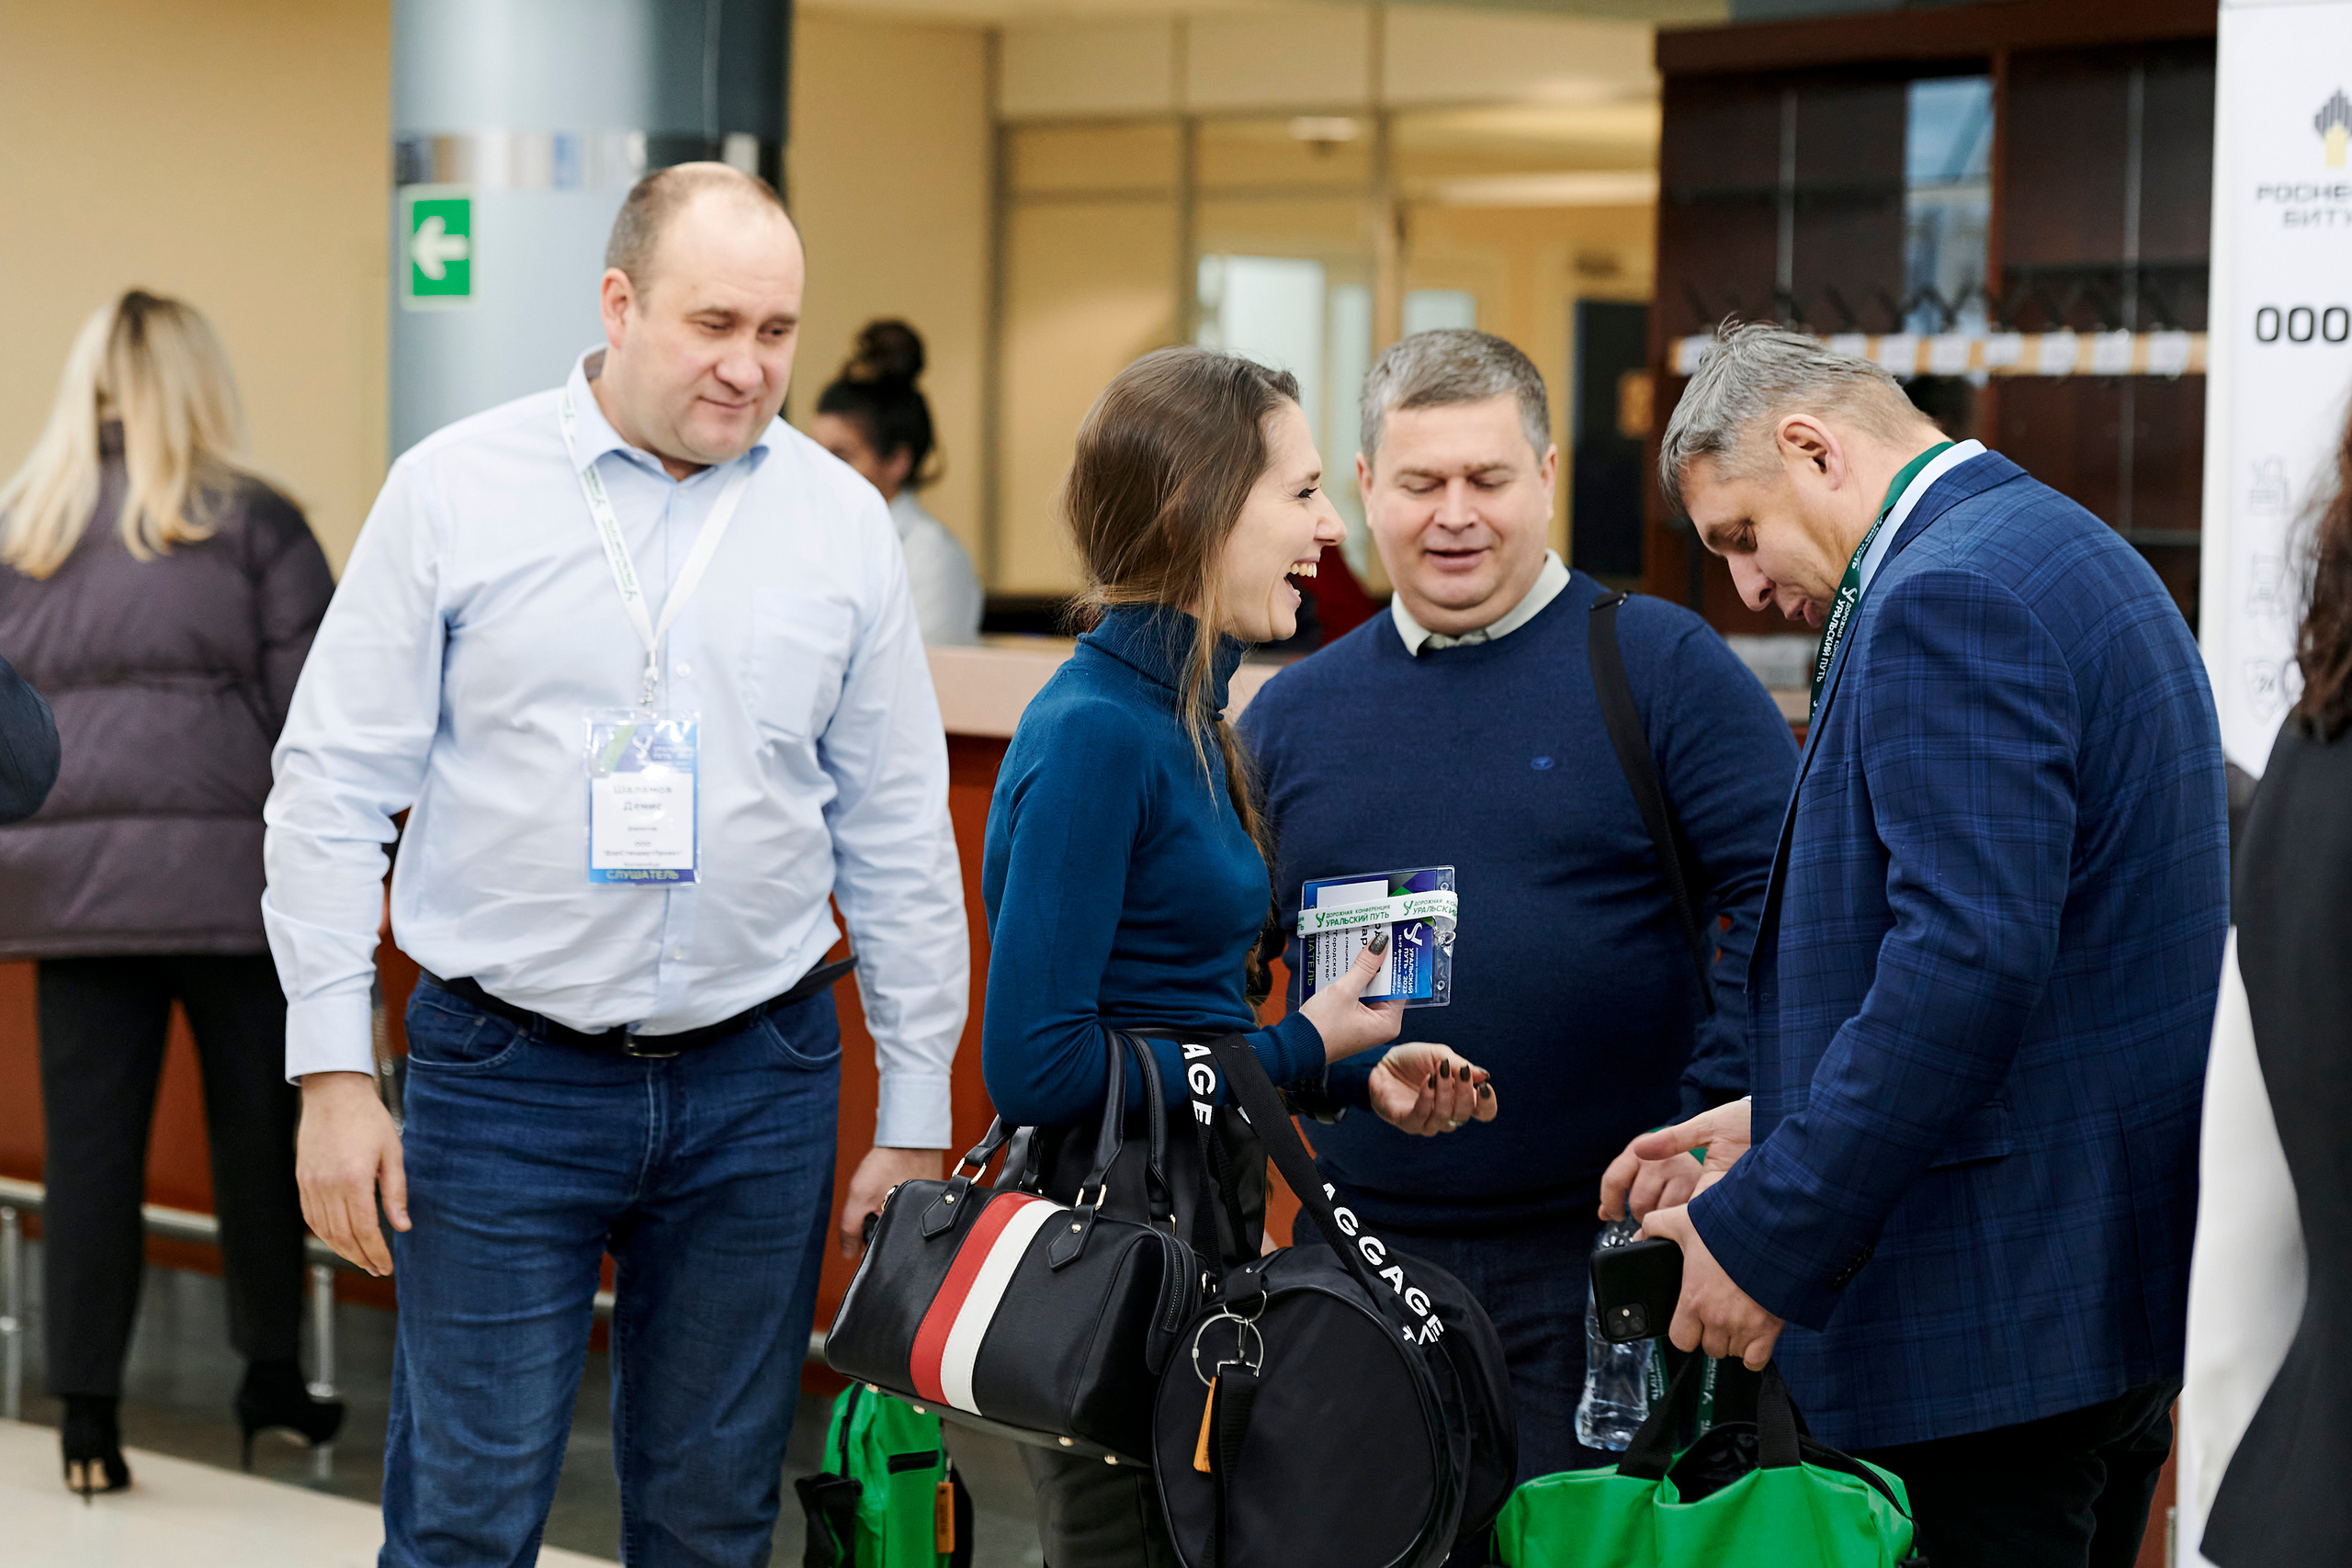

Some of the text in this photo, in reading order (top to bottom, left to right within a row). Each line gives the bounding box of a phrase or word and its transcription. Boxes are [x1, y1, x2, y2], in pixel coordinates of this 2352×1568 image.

[1823, 599, 1846, 657] УРАЛЬСКИЙ
[1815, 657, 1828, 682] ПУТЬ
[1326, 911, 1389, 927] УРАЛЬСКИЙ ПУТЬ
[1355, 905, 1391, 915] КОНФЕРЕНЦИЯ
